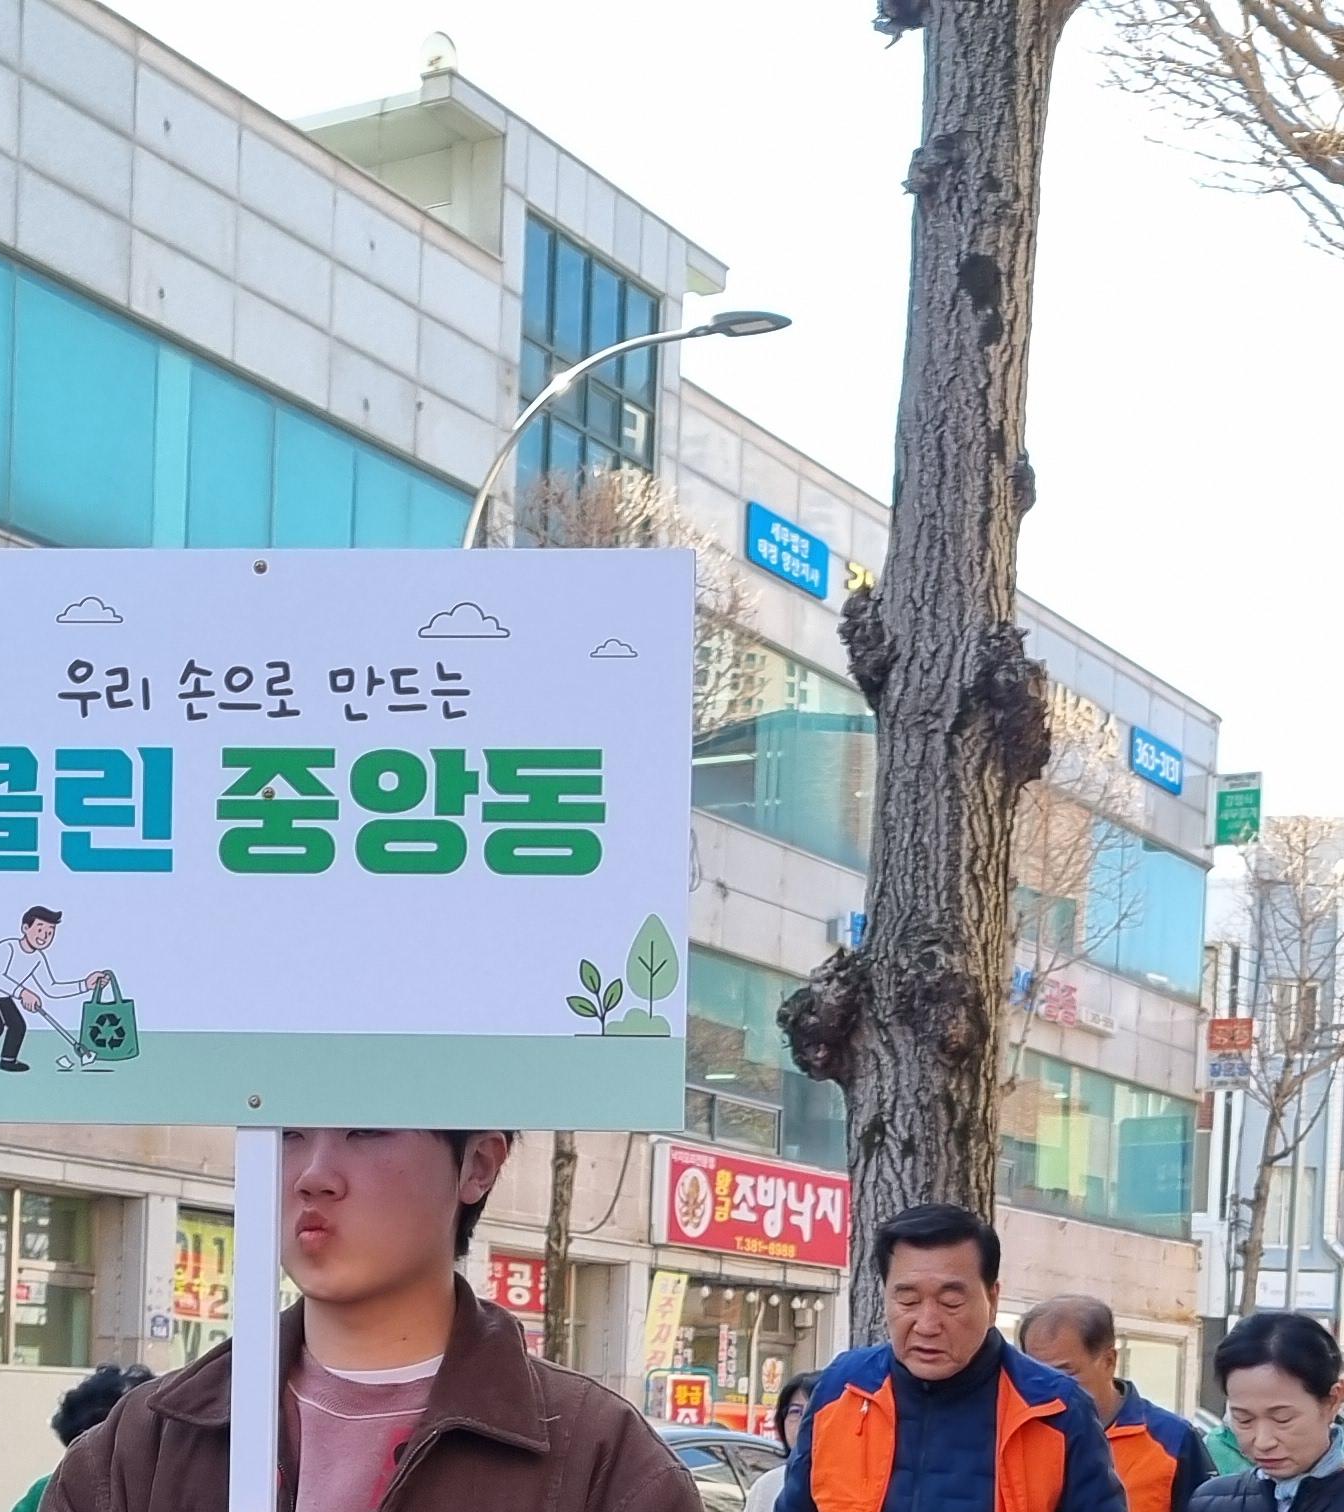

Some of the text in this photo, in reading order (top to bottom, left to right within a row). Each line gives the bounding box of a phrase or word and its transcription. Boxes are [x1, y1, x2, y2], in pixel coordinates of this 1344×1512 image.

[56, 657, 472, 723] 우리 손으로 만드는
[216, 746, 609, 876] 중앙동
[730, 1173, 844, 1244] 조방낙지
